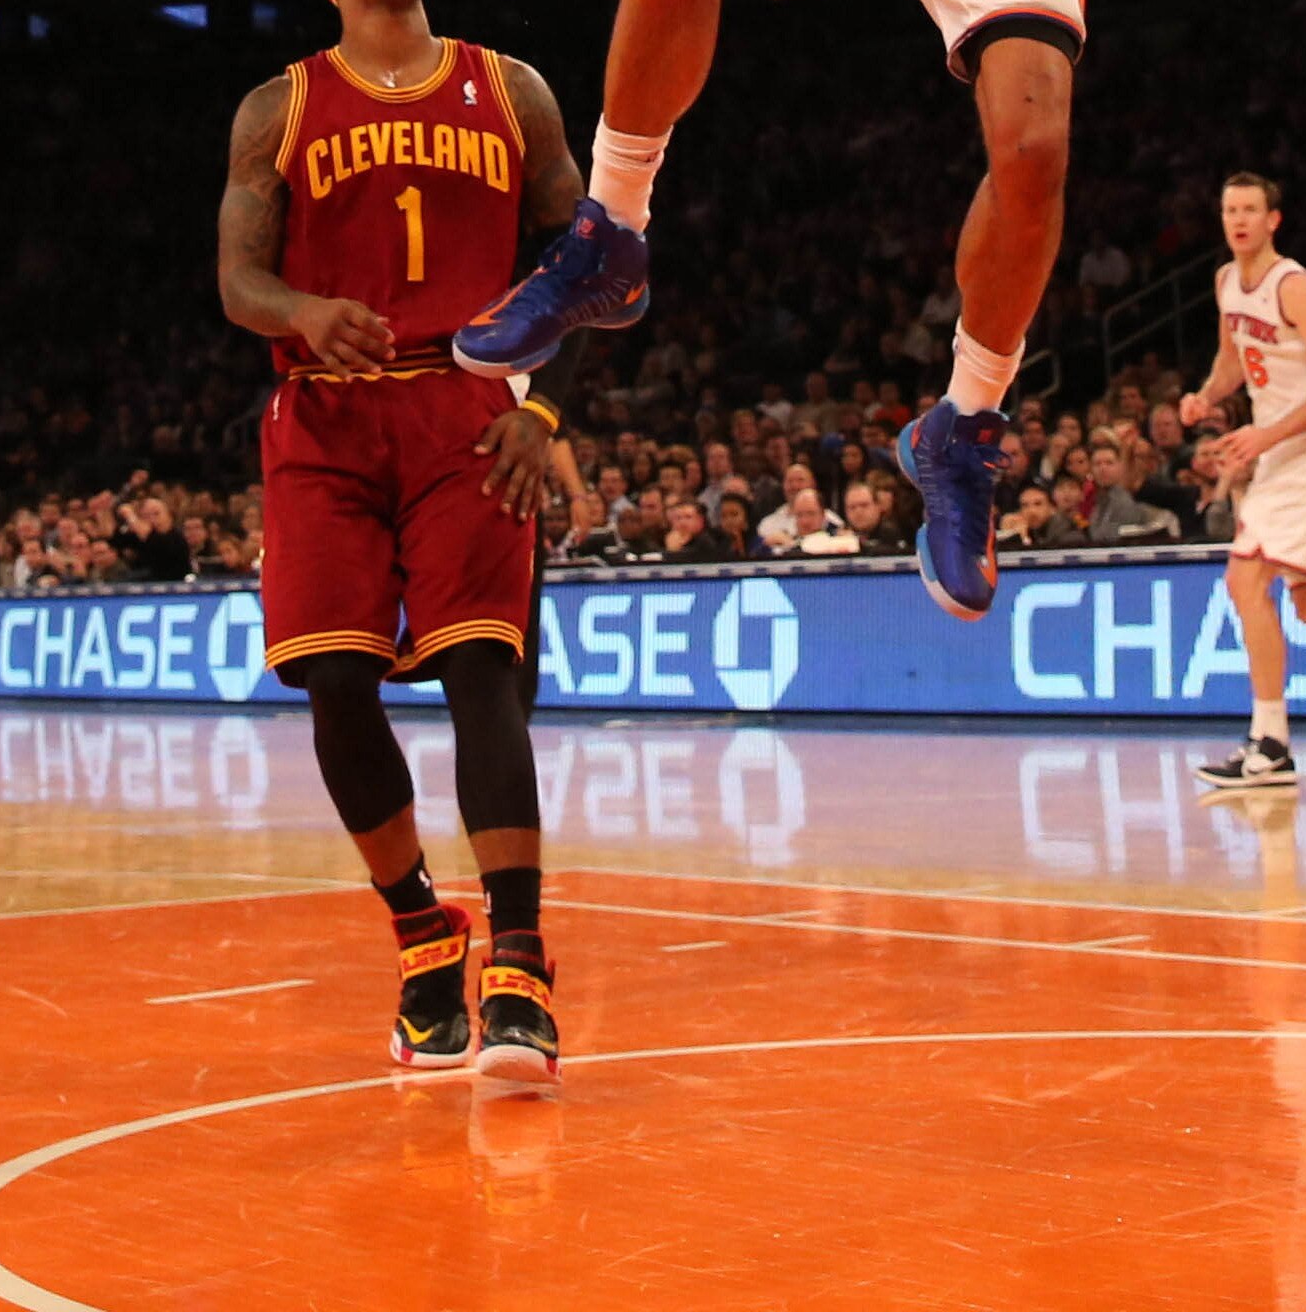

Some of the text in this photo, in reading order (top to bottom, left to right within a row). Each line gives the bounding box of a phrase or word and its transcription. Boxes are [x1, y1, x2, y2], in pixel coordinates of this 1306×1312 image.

[305, 120, 511, 201] CLEVELAND
[395, 185, 425, 282] 1
[0, 606, 199, 688] CHASE
